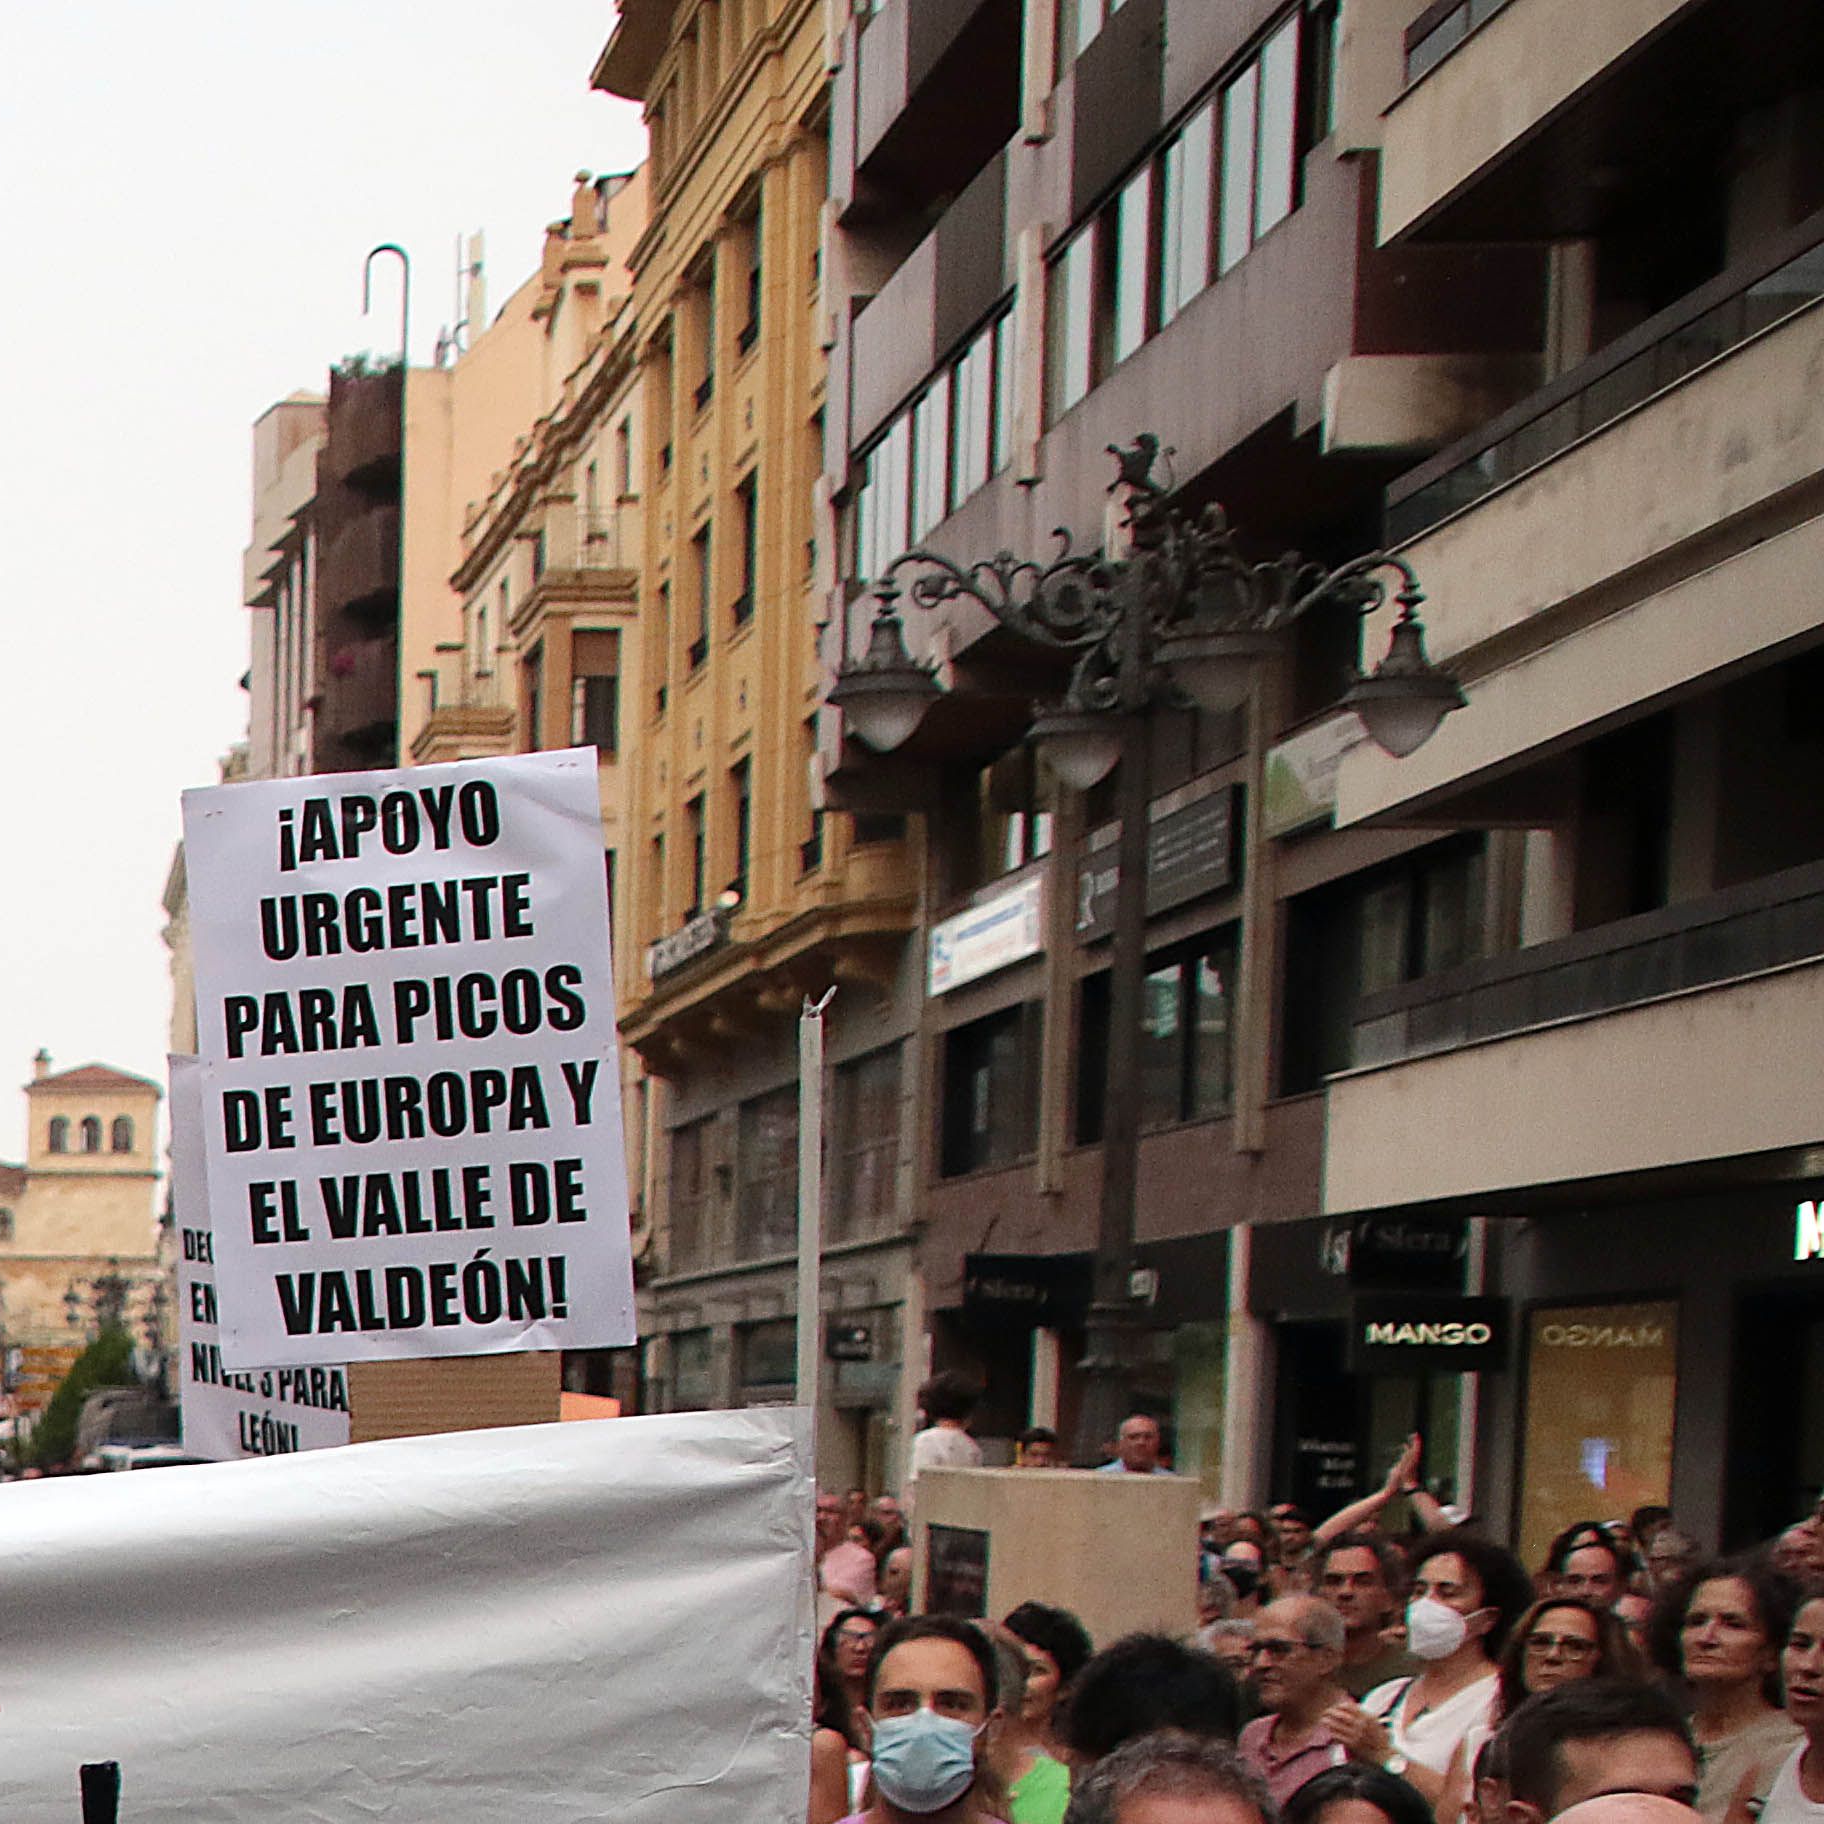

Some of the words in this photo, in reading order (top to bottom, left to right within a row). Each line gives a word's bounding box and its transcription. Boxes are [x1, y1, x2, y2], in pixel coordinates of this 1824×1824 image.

[279, 779, 501, 873] ¡APOYO
[260, 872, 534, 962] URGENTE
[223, 982, 381, 1060] PARA
[392, 963, 587, 1045] PICOS
[222, 1085, 296, 1153] DE
[309, 1065, 551, 1147] EUROPA
[560, 1058, 600, 1126] Y
[248, 1178, 311, 1245] EL
[319, 1163, 496, 1241] VALLE
[508, 1157, 588, 1227] DE
[274, 1247, 569, 1337] VALDEÓN!
[1365, 1322, 1491, 1345] MANGO
